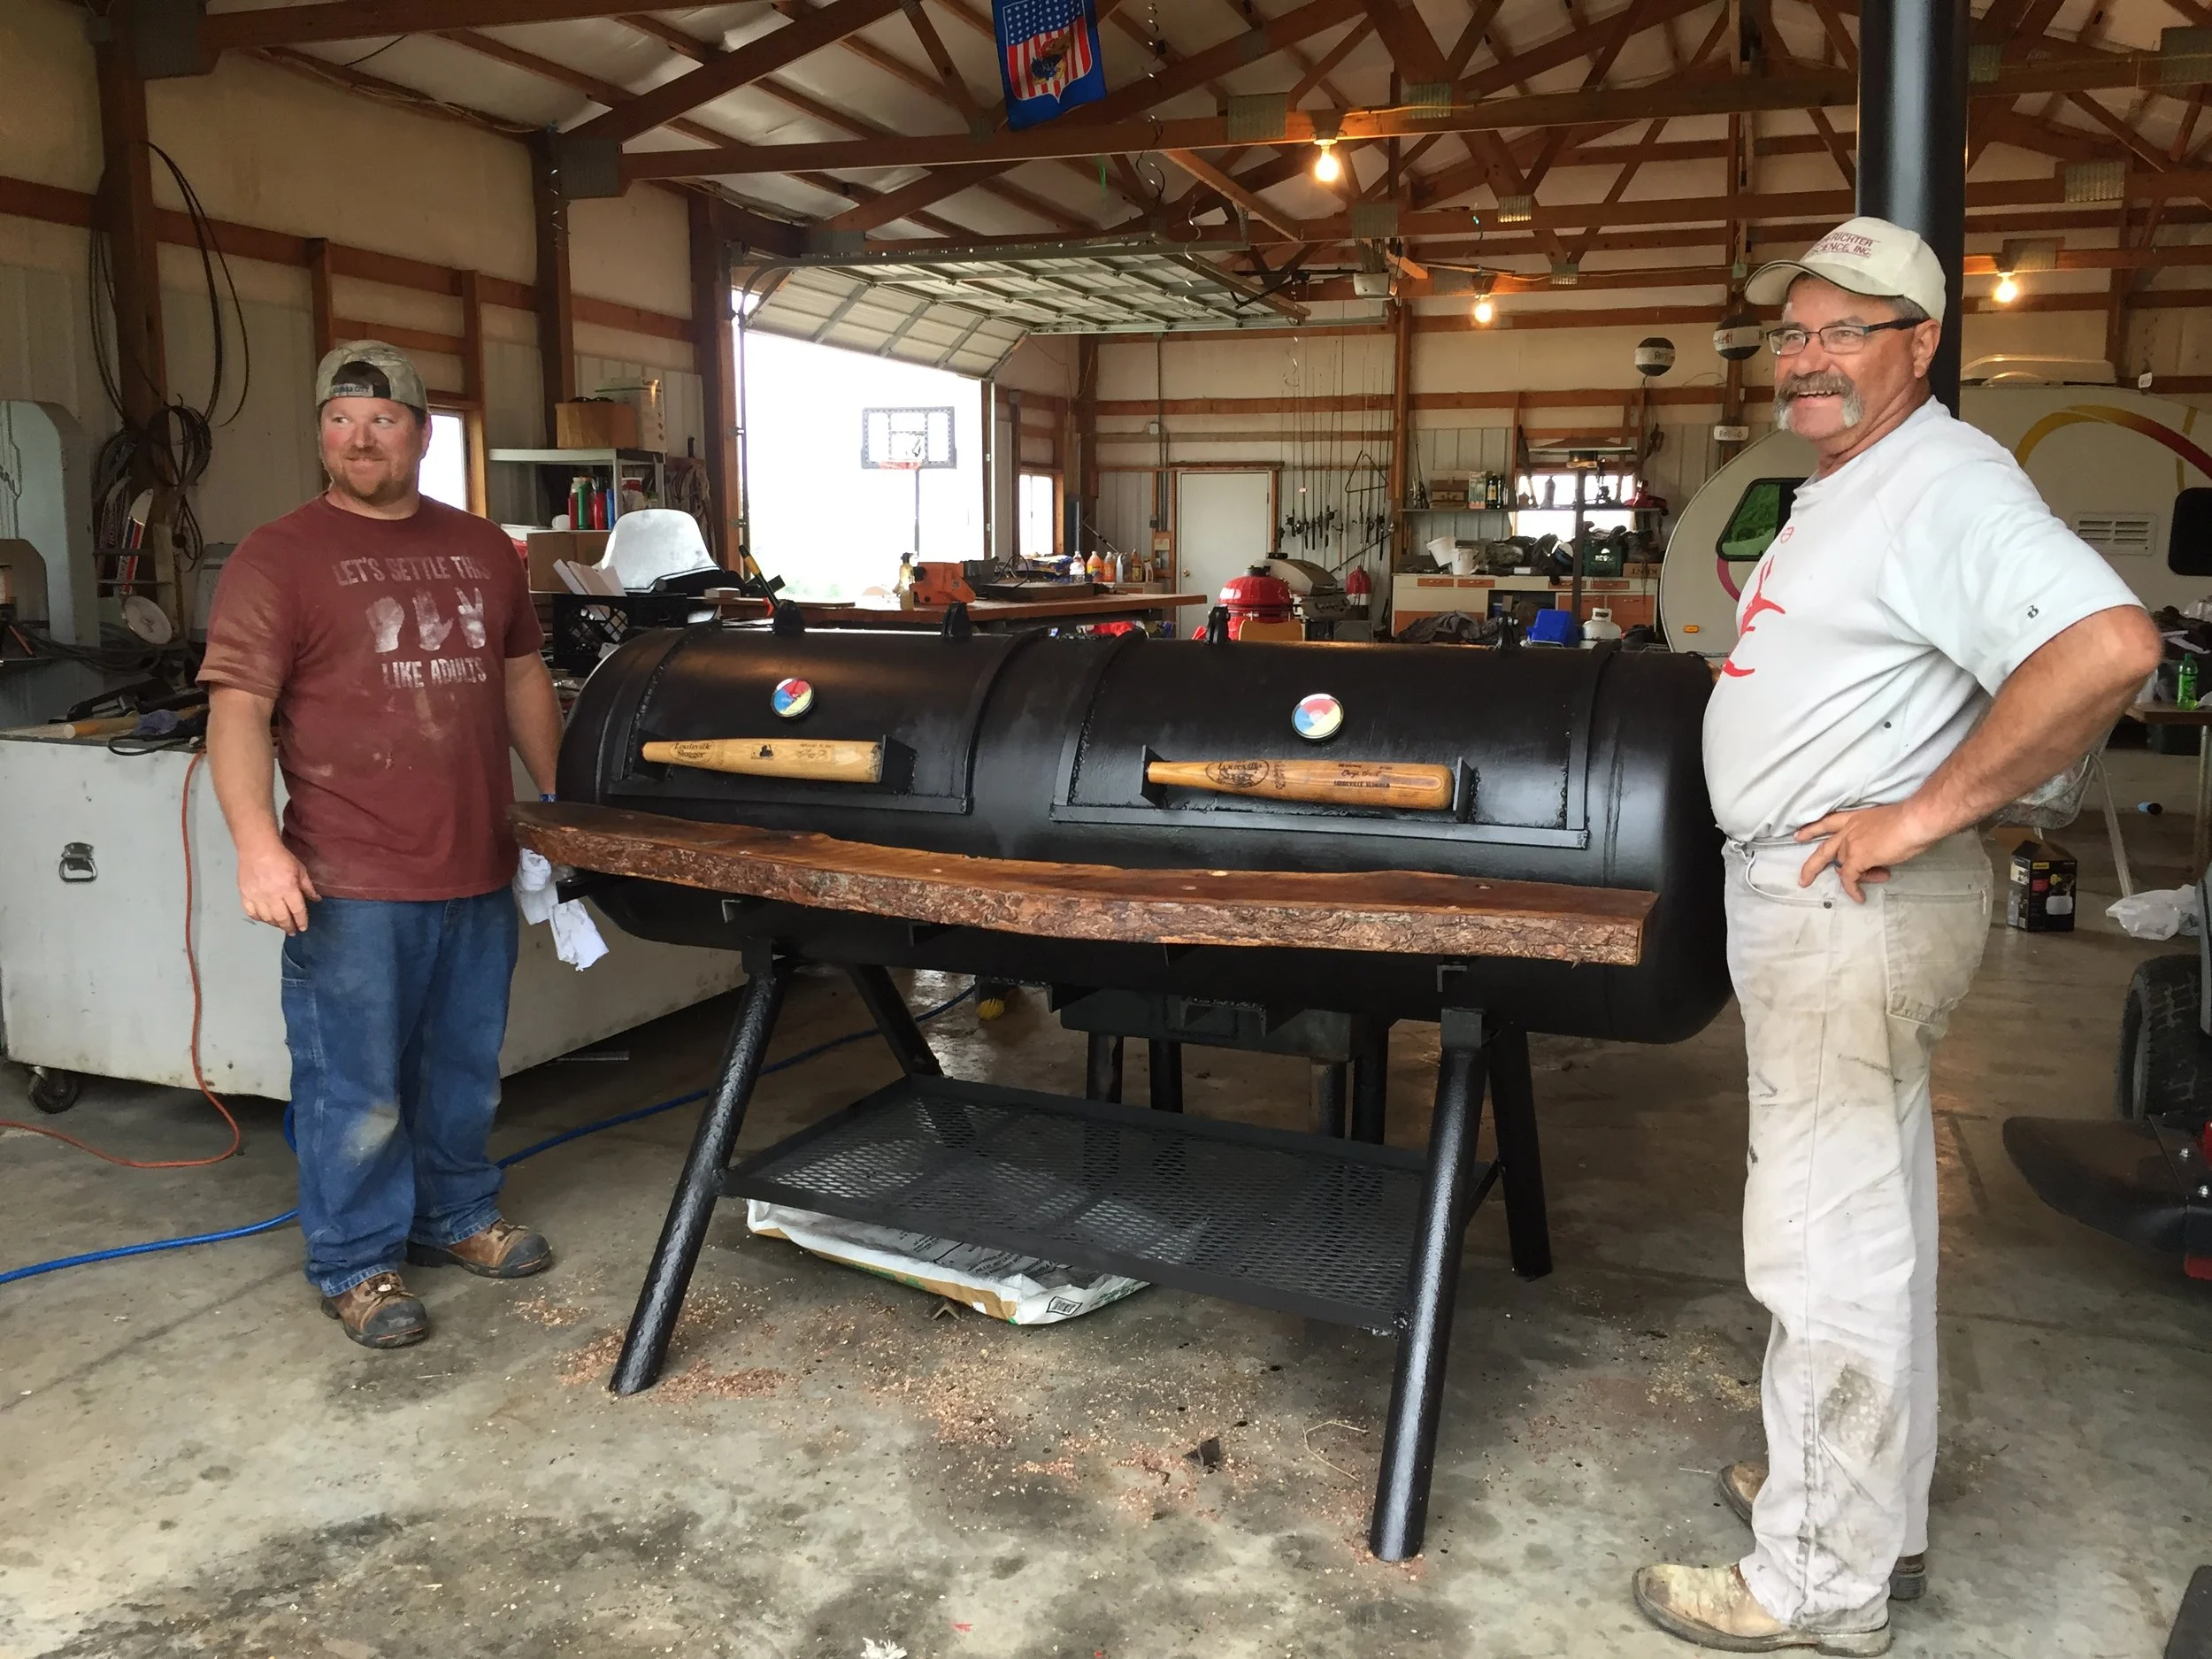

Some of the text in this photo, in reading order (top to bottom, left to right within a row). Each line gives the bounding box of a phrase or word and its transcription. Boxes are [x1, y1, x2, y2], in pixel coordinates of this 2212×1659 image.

[332, 556, 491, 586] LET'S SETTLE THIS
[381, 657, 488, 688] LIKE ADULTS
